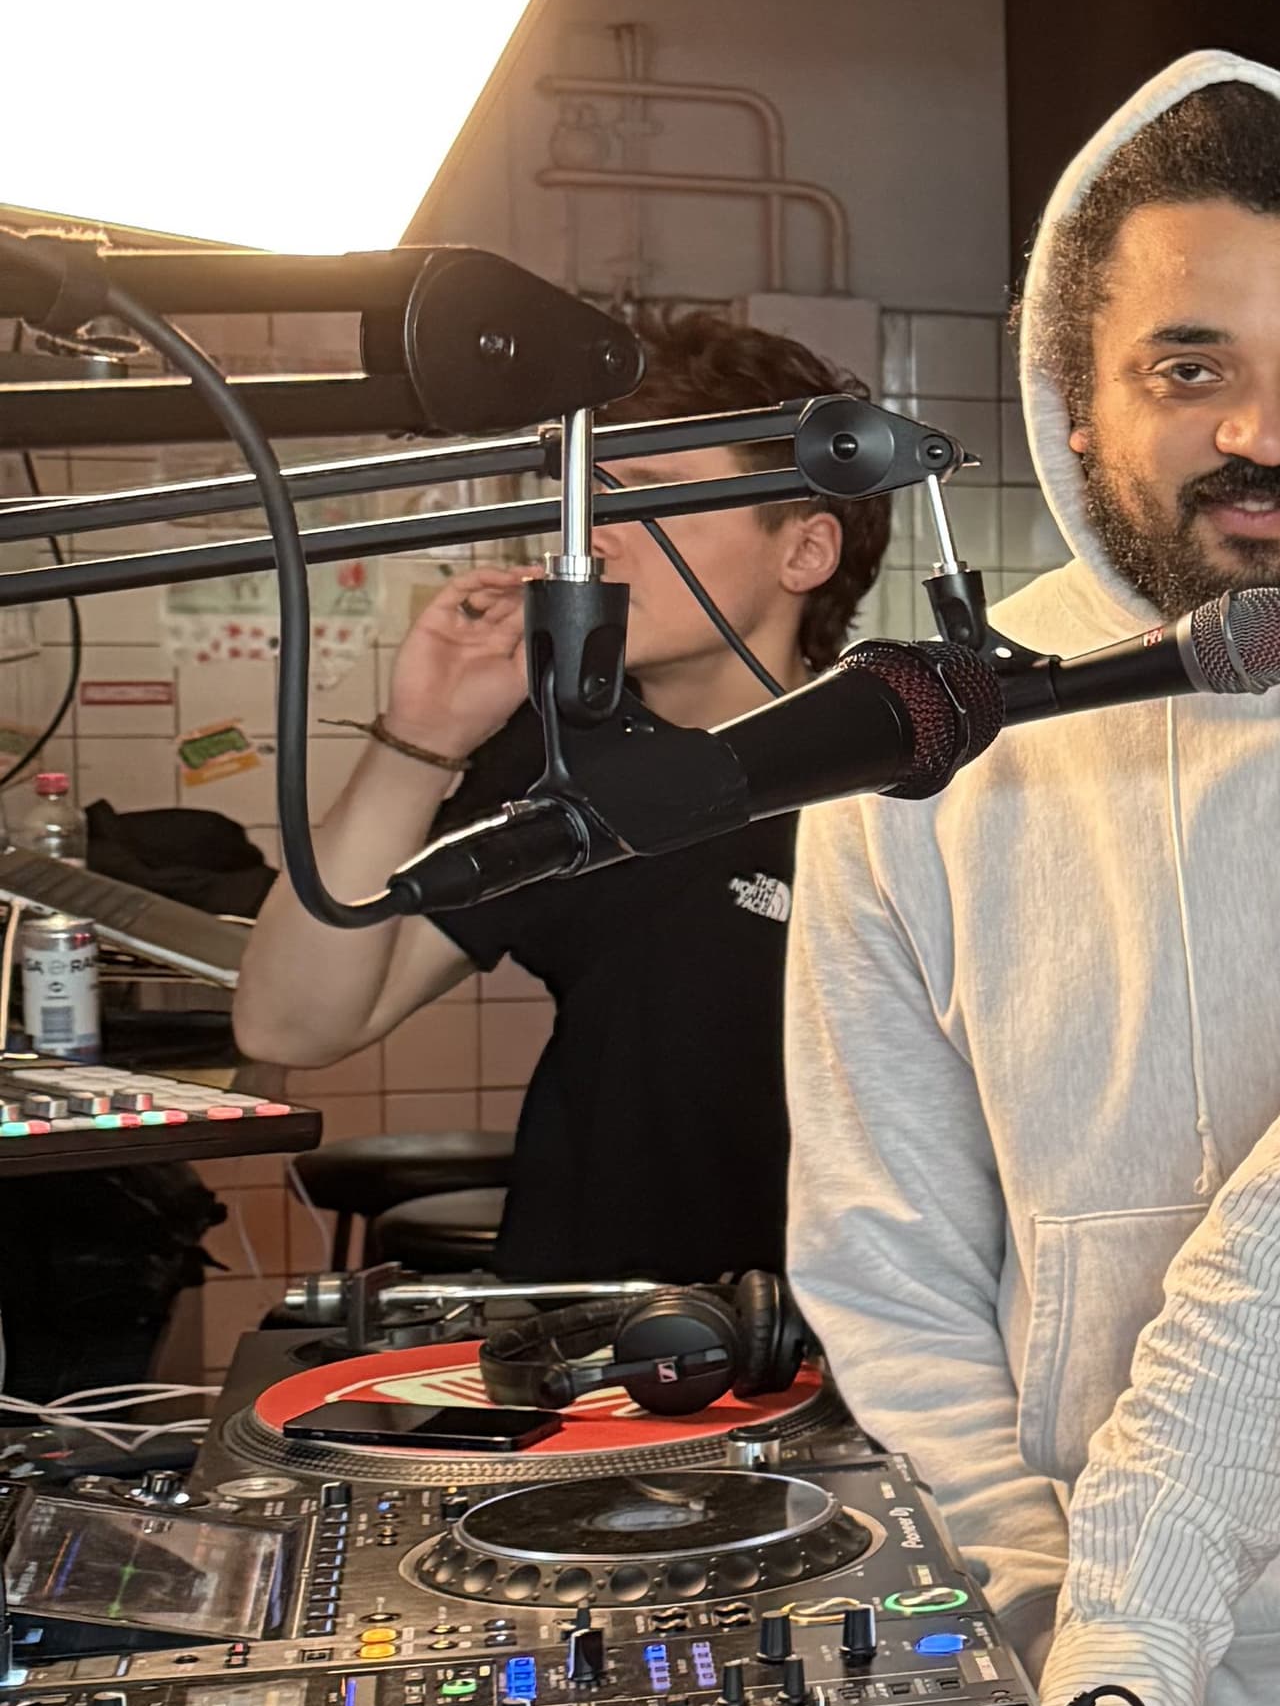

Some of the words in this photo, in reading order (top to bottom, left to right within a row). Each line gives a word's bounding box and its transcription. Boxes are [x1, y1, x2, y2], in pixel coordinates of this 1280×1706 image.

[729, 878, 775, 905] NORTH
[754, 872, 777, 893] THE
[735, 895, 771, 918] FACE
